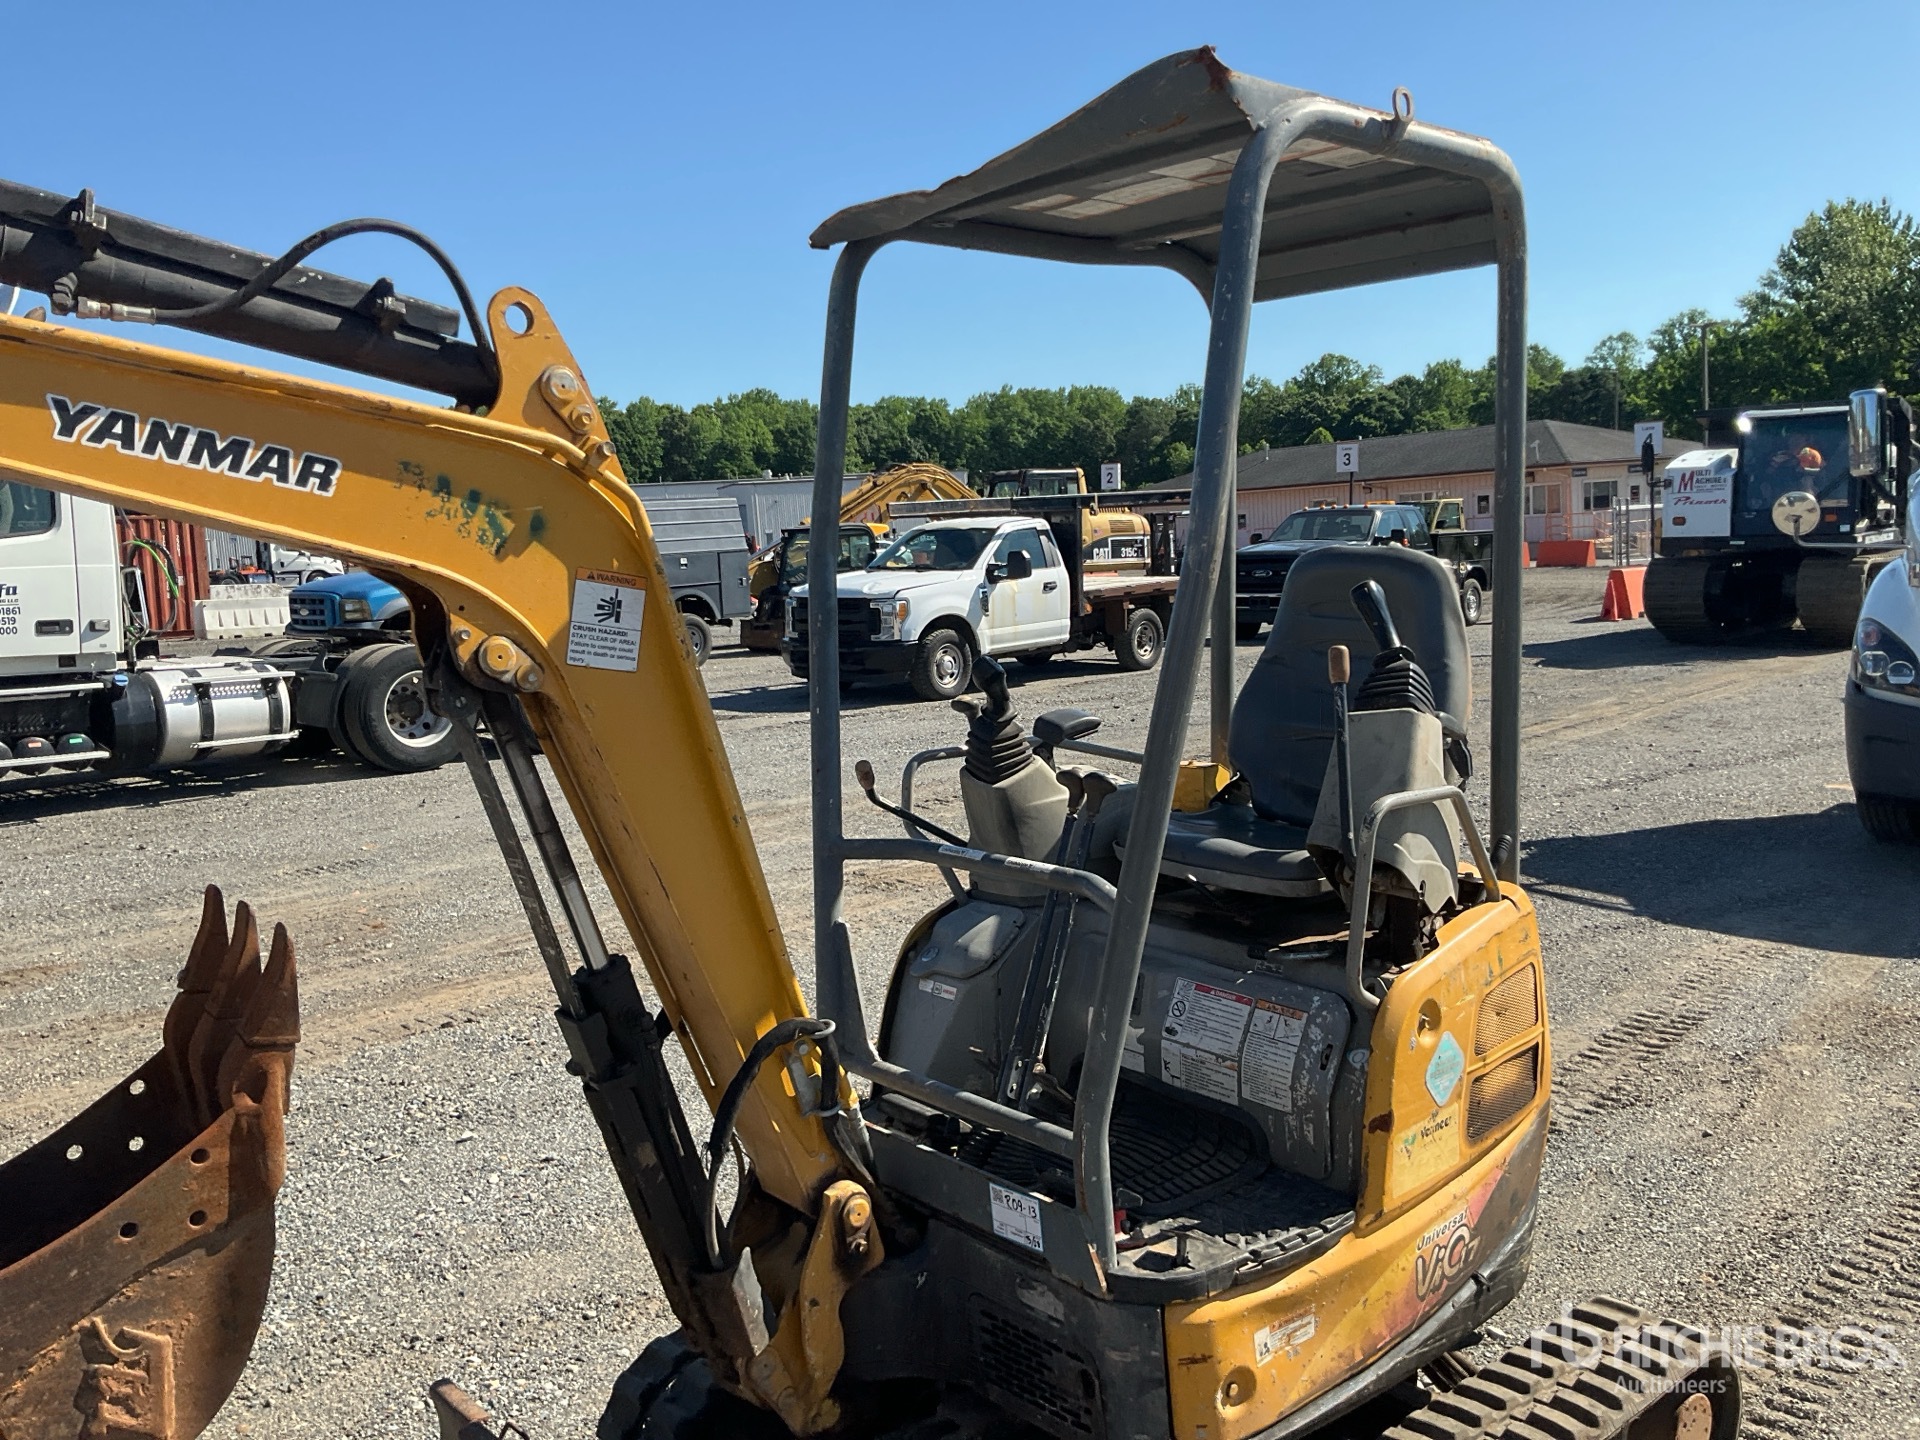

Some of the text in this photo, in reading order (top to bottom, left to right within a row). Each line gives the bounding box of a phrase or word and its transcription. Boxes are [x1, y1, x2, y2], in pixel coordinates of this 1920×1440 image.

[48, 395, 342, 495] YANMAR
[1343, 453, 1351, 467] 3
[1106, 472, 1113, 484] 2
[1093, 548, 1110, 560] CAT
[1121, 547, 1138, 558] 315C
[596, 572, 637, 587] WARNING
[0, 607, 21, 615] 1861
[1, 617, 16, 625] 519
[572, 624, 628, 637] CRUSH HAZARD!
[571, 632, 587, 640] STAY
[588, 634, 609, 642] CLEAR
[1416, 1206, 1469, 1251] Universal
